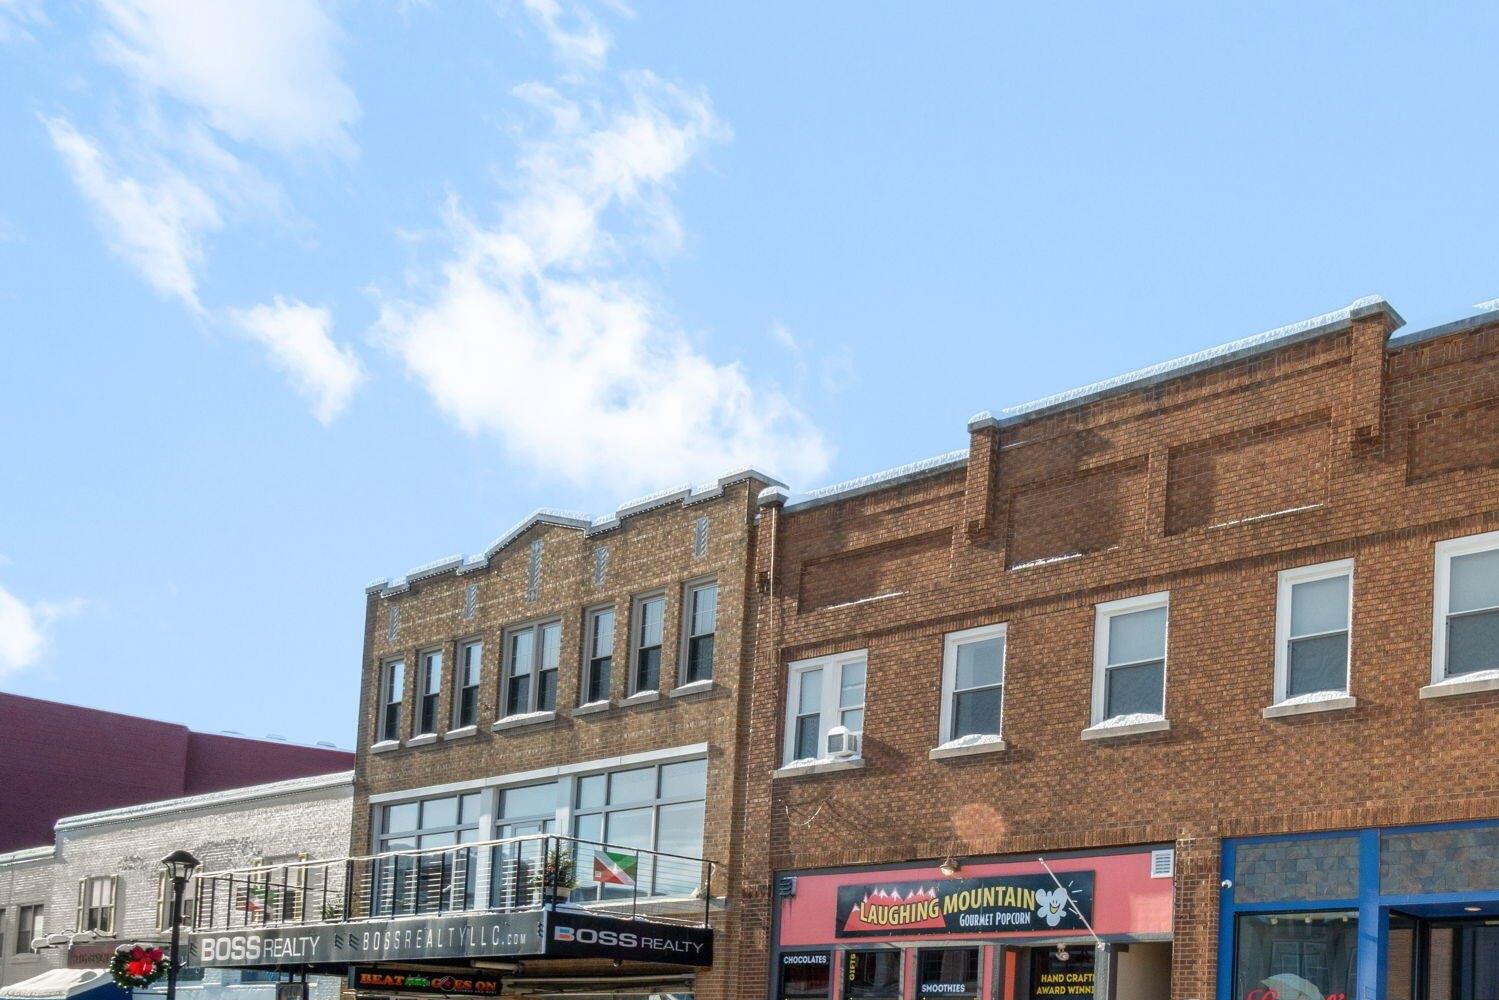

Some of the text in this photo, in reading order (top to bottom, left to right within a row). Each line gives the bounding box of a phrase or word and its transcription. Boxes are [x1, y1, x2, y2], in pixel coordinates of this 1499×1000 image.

[859, 886, 1036, 926] LAUGHING MOUNTAIN
[959, 911, 1031, 927] GOURMET POPCORN
[554, 926, 704, 954] BOSS REALTY
[201, 935, 320, 962] BOSS REALTY
[783, 955, 827, 965] CHOCOLATES
[360, 972, 405, 986] BEAT
[475, 980, 497, 991] ON
[1041, 973, 1094, 982] HAND CRAFT
[921, 983, 966, 993] SMOOTHIES
[1036, 986, 1066, 995] AWARD
